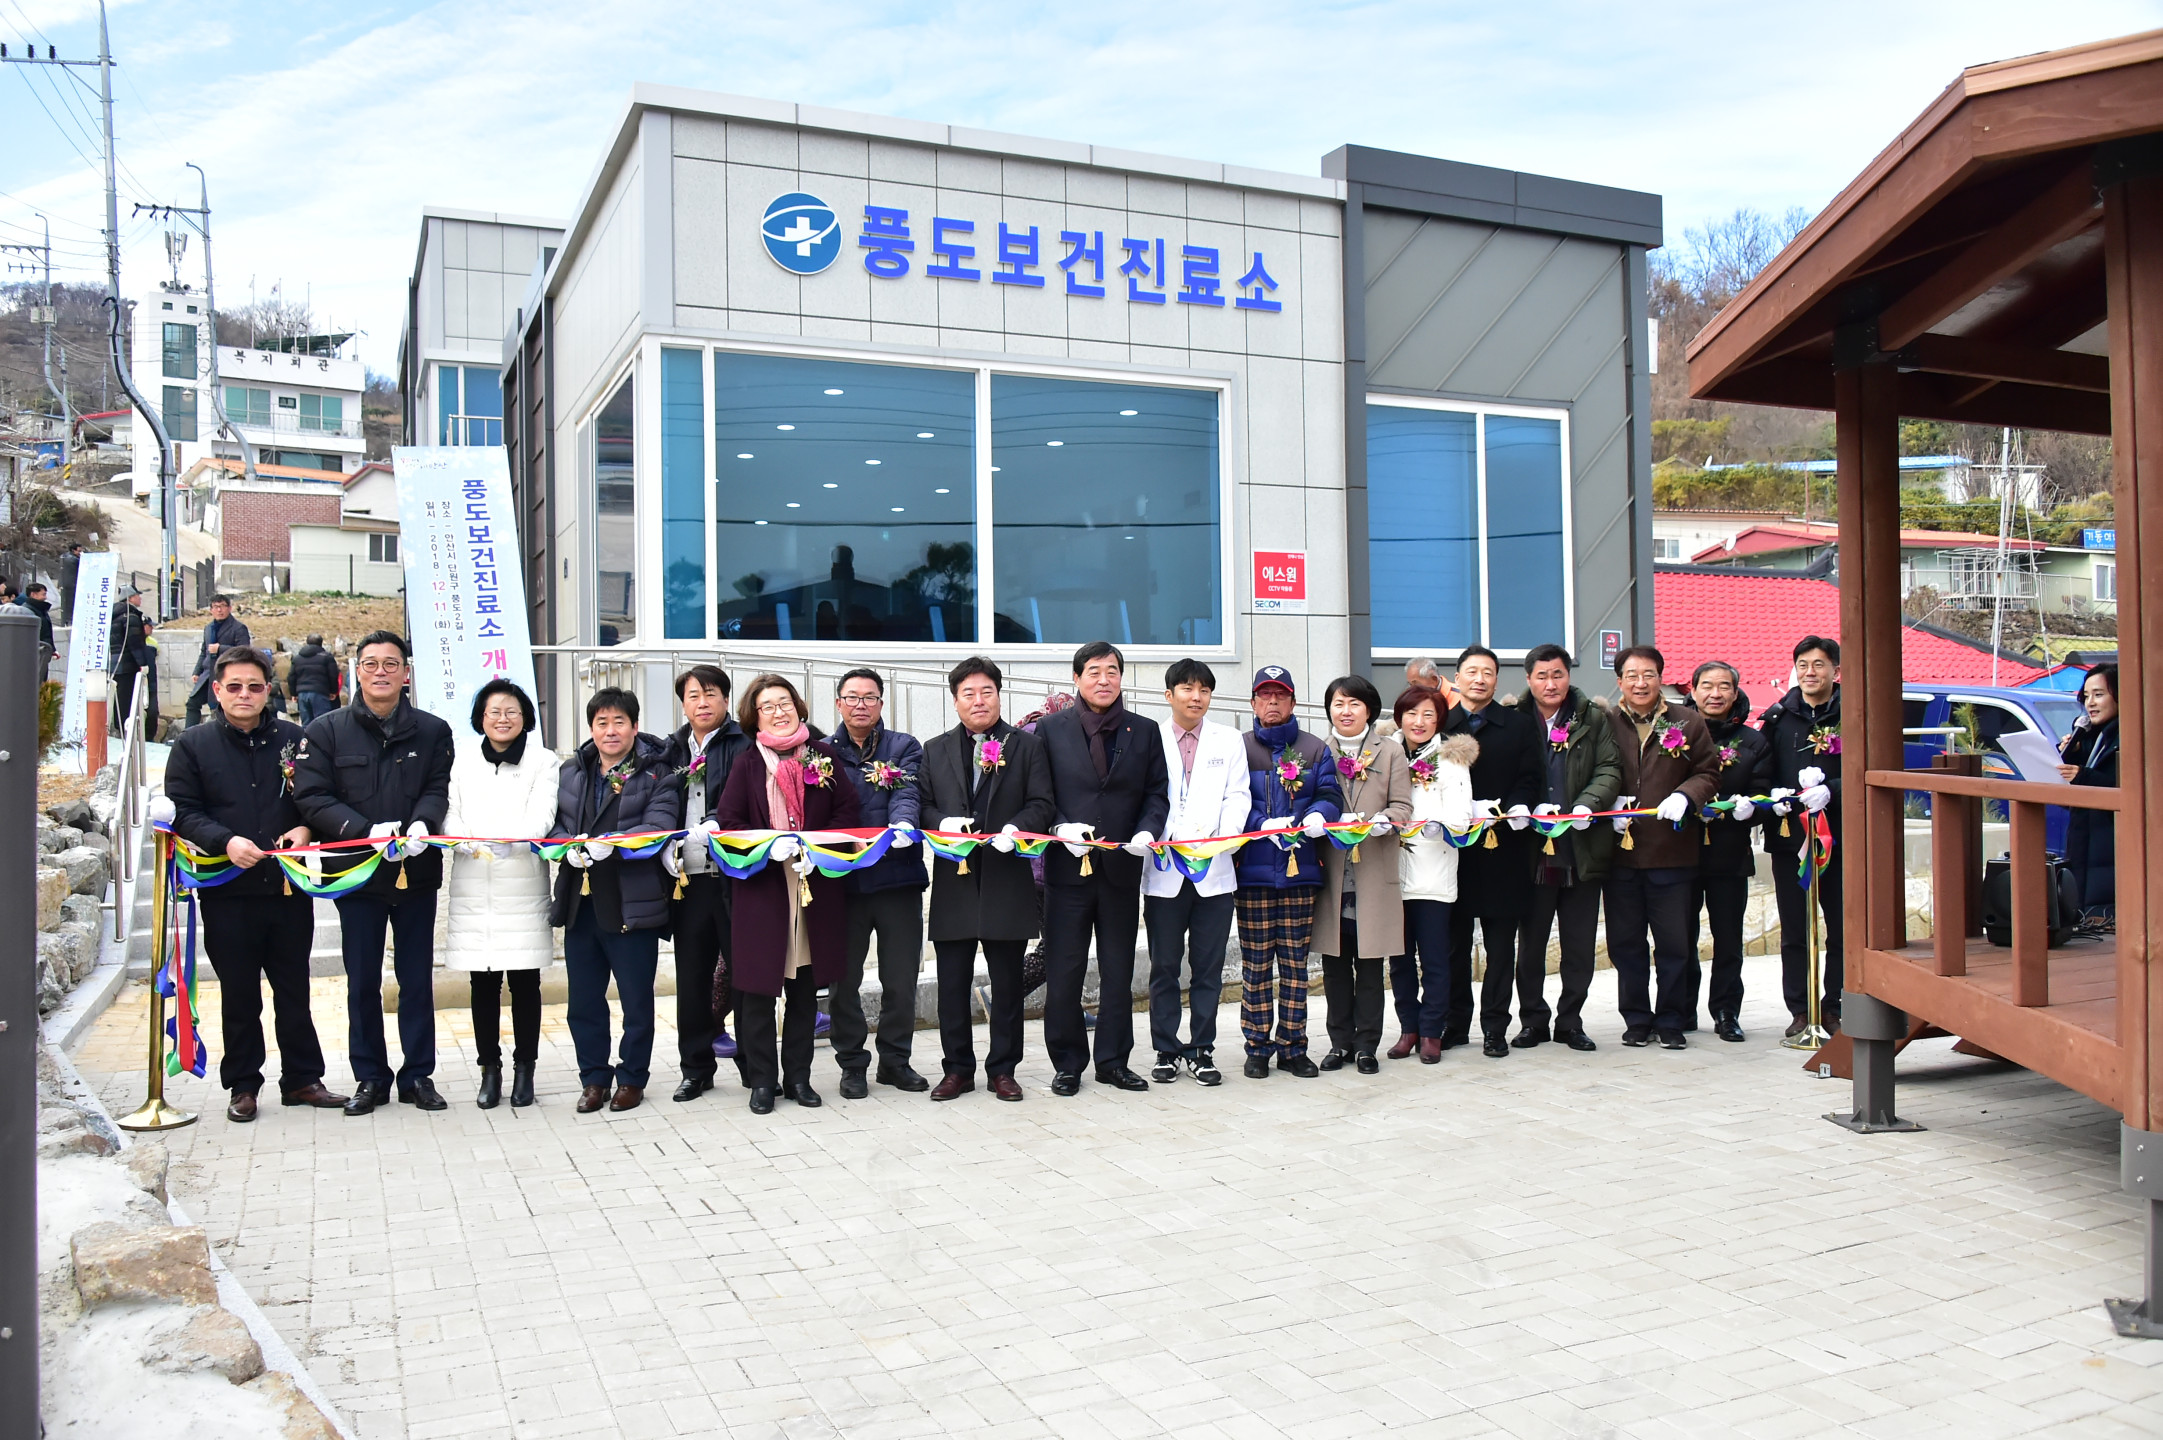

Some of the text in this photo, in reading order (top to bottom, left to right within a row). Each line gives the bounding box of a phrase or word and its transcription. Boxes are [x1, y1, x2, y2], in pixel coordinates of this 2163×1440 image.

[858, 204, 1282, 312] 풍도보건진료소
[234, 349, 330, 372] 복지회관
[425, 501, 436, 519] 일시
[441, 501, 452, 518] 장소
[444, 533, 456, 560] 안산시
[461, 479, 505, 638] 풍도보건진료소
[1262, 566, 1297, 583] 에스원
[1255, 600, 1281, 608] SECOM
[440, 637, 451, 655] 오전
[441, 659, 453, 677] 11시
[443, 682, 456, 700] 30분
